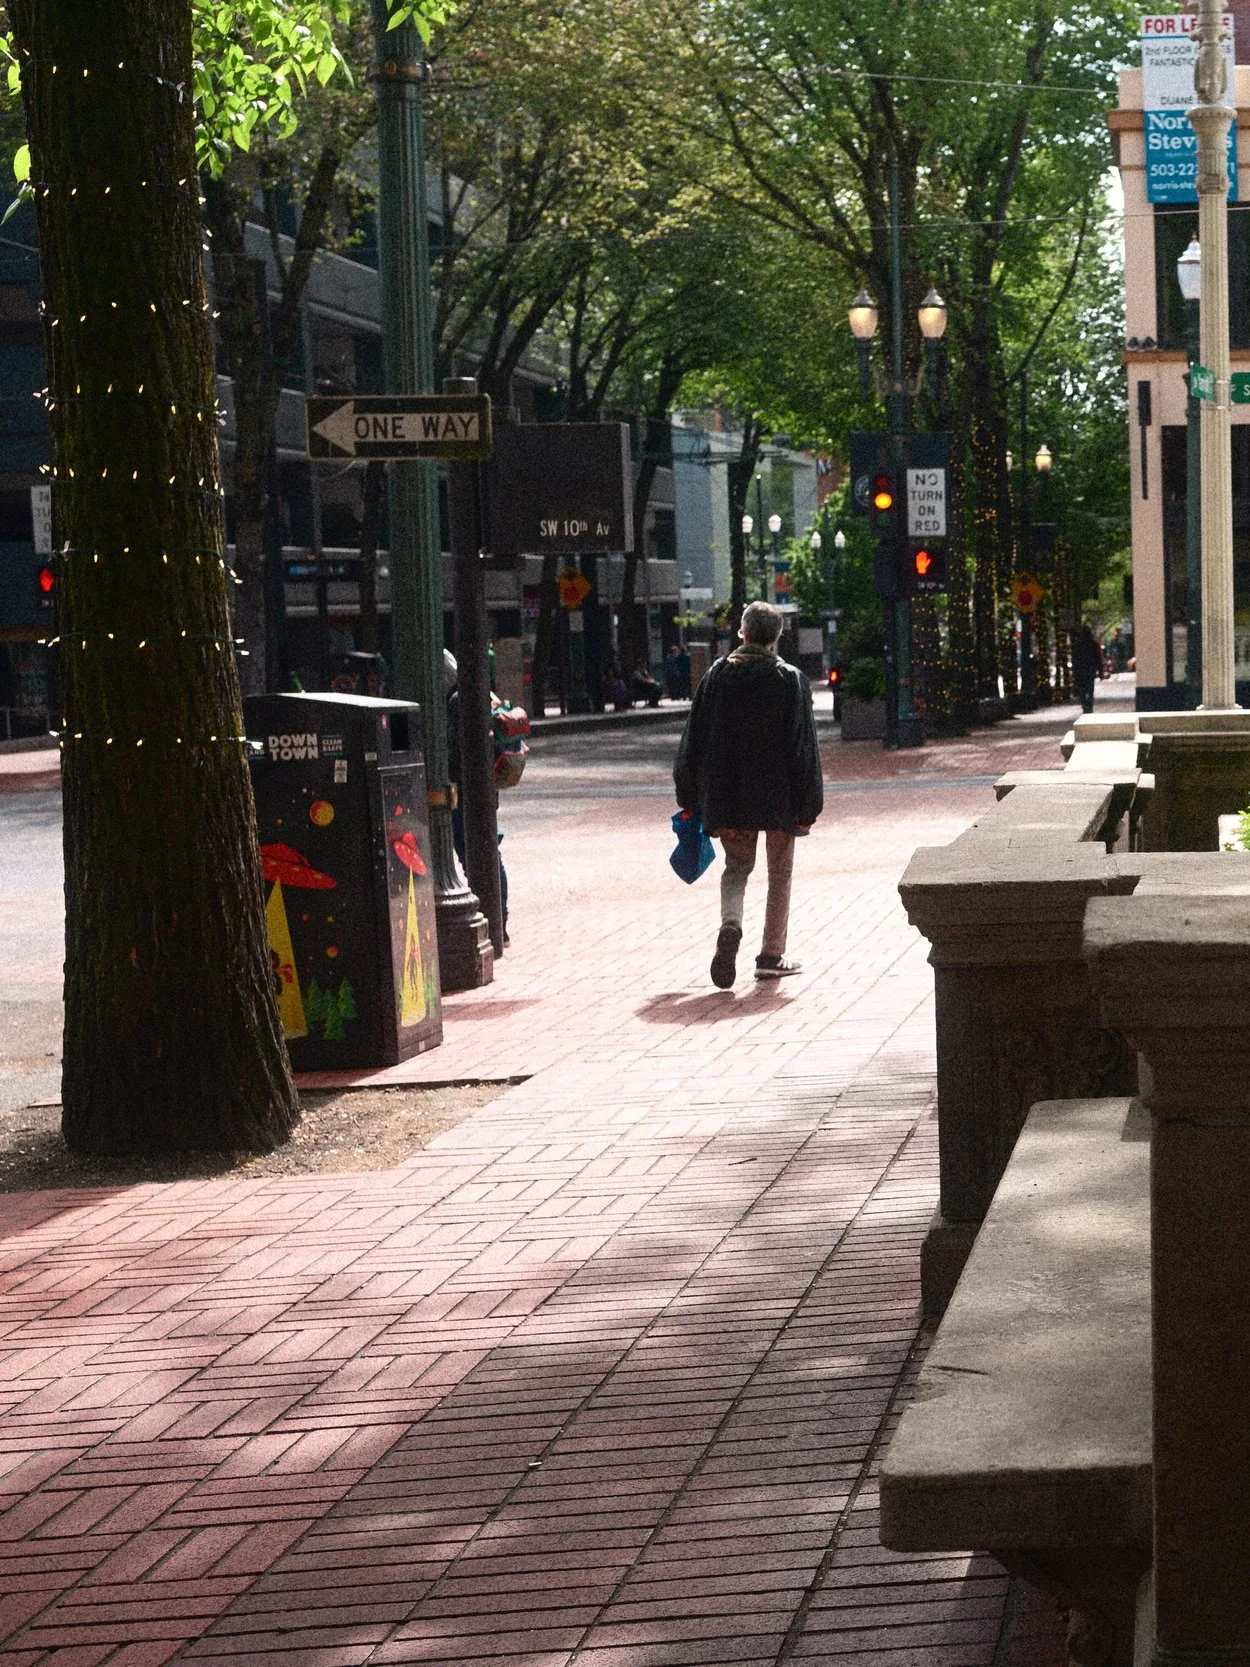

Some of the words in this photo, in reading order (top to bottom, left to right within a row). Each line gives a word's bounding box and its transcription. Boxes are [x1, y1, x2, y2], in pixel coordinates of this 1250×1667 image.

[1145, 18, 1175, 33] FOR
[1181, 17, 1230, 32] LEE
[1164, 46, 1192, 54] FLOOR
[1149, 58, 1194, 66] FANTASTIC
[1147, 113, 1193, 130] Nor
[1148, 133, 1233, 150] Stevs
[354, 416, 405, 439] ONE
[422, 415, 474, 438] WAY
[915, 473, 938, 486] NO
[910, 490, 943, 501] TURN
[918, 505, 936, 516] ON
[540, 520, 557, 536] SW
[563, 519, 588, 536] 10th
[596, 522, 609, 536] Av
[915, 520, 940, 531] RED
[268, 733, 318, 748] DOWN
[269, 747, 319, 761] TOWN
